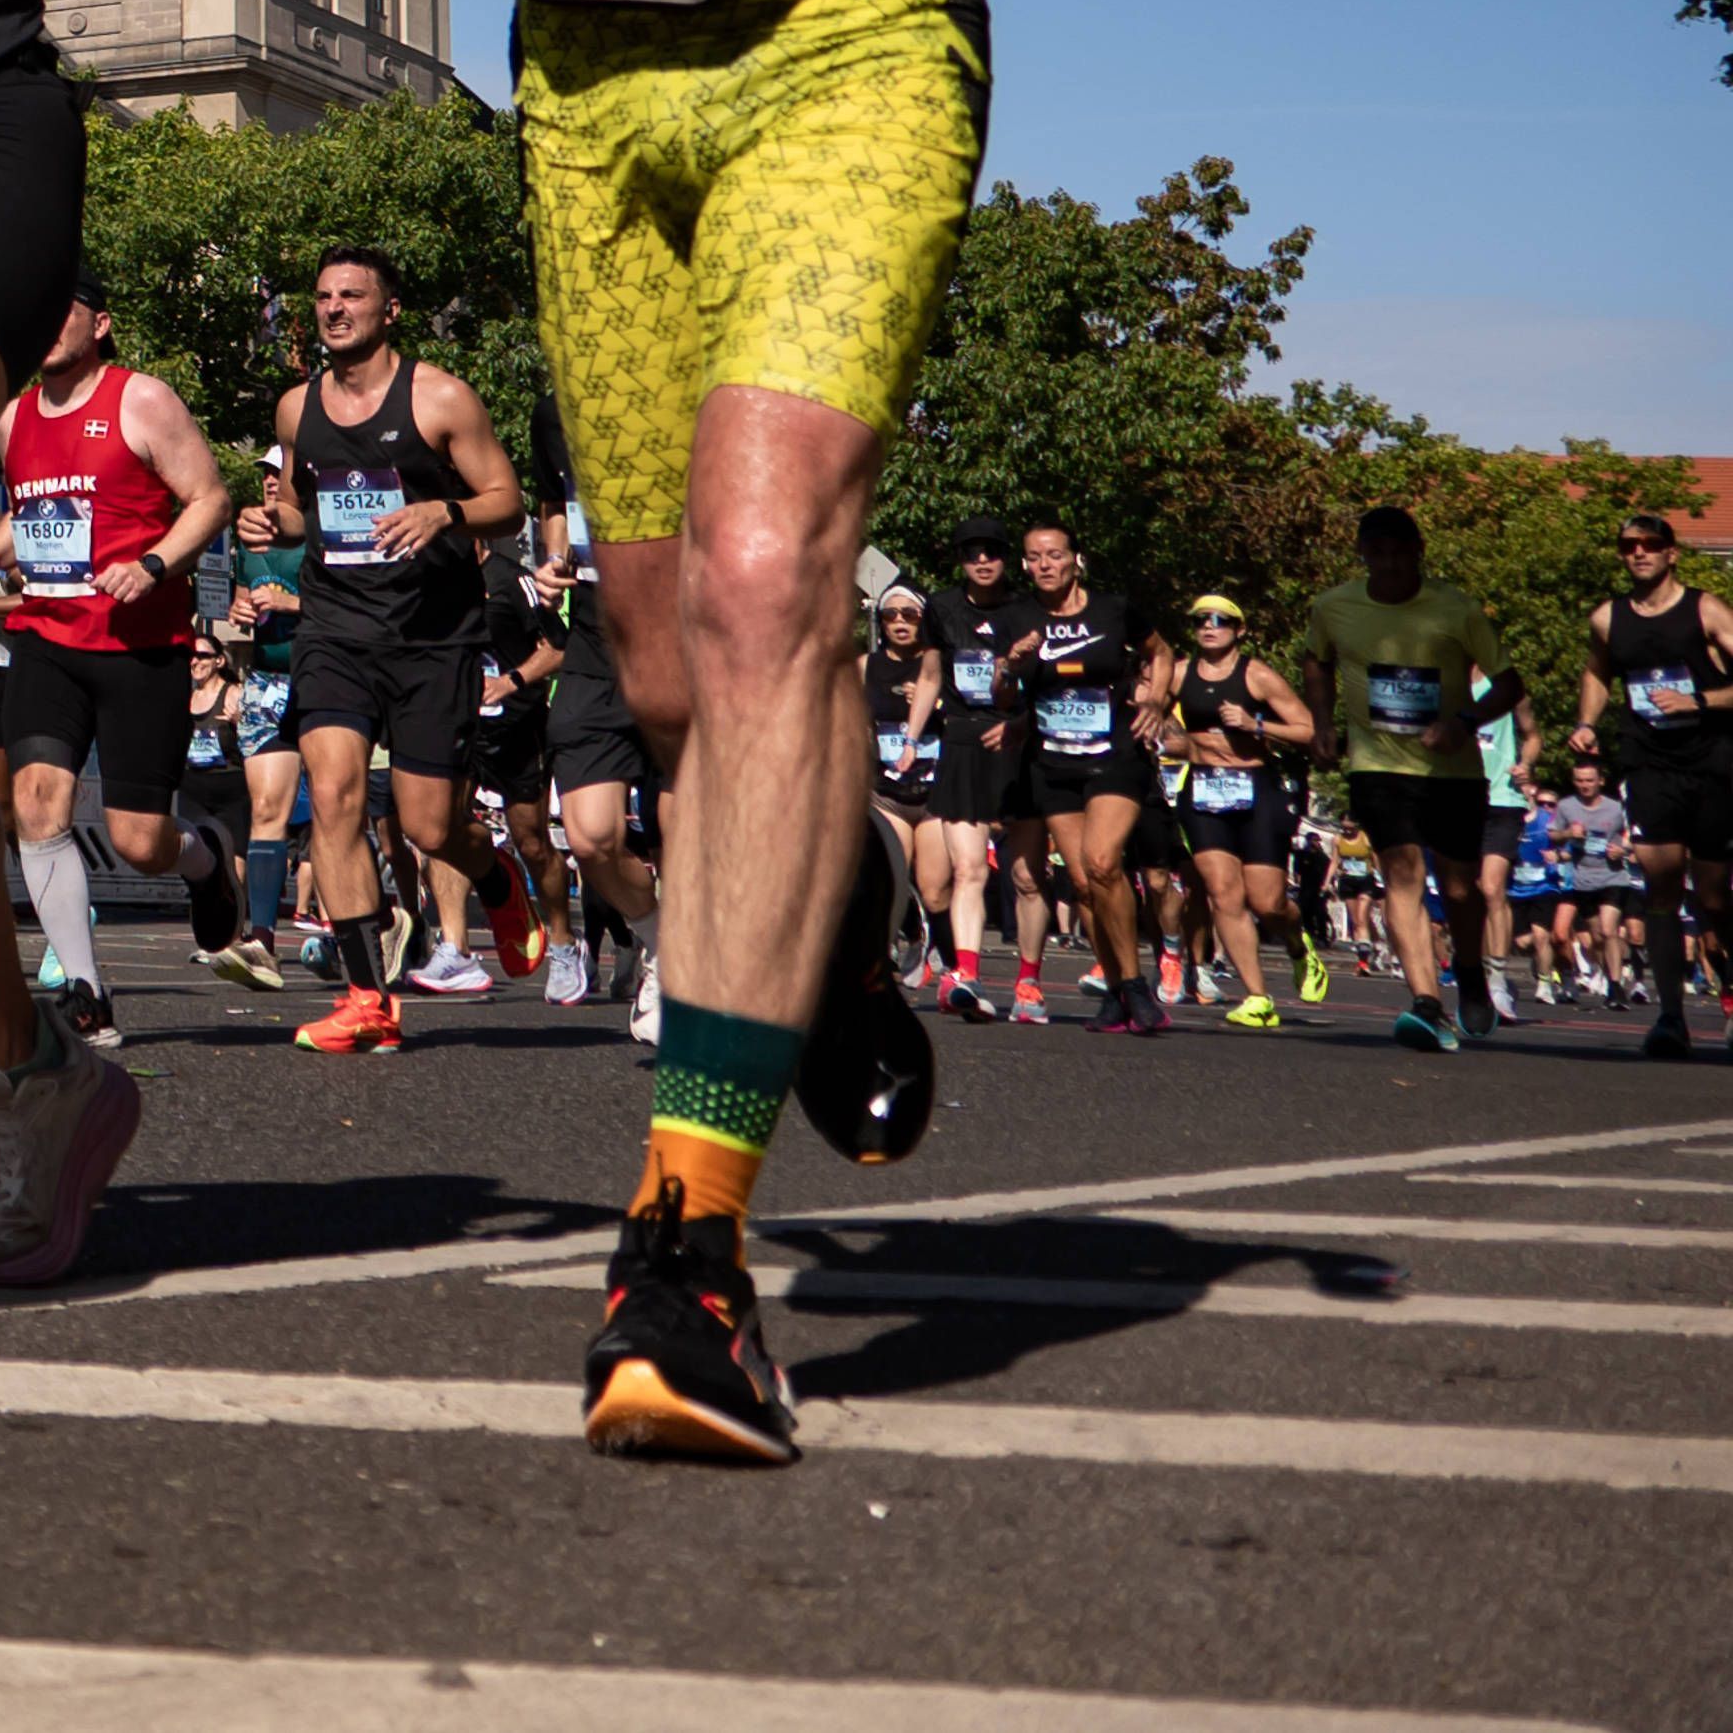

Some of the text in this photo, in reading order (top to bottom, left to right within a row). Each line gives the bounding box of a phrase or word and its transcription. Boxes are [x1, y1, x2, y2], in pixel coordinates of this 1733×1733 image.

[14, 475, 98, 500] DENMARK
[333, 493, 386, 509] 56124
[21, 522, 75, 539] 16807
[1046, 623, 1090, 640] LOLA
[966, 666, 993, 678] 874
